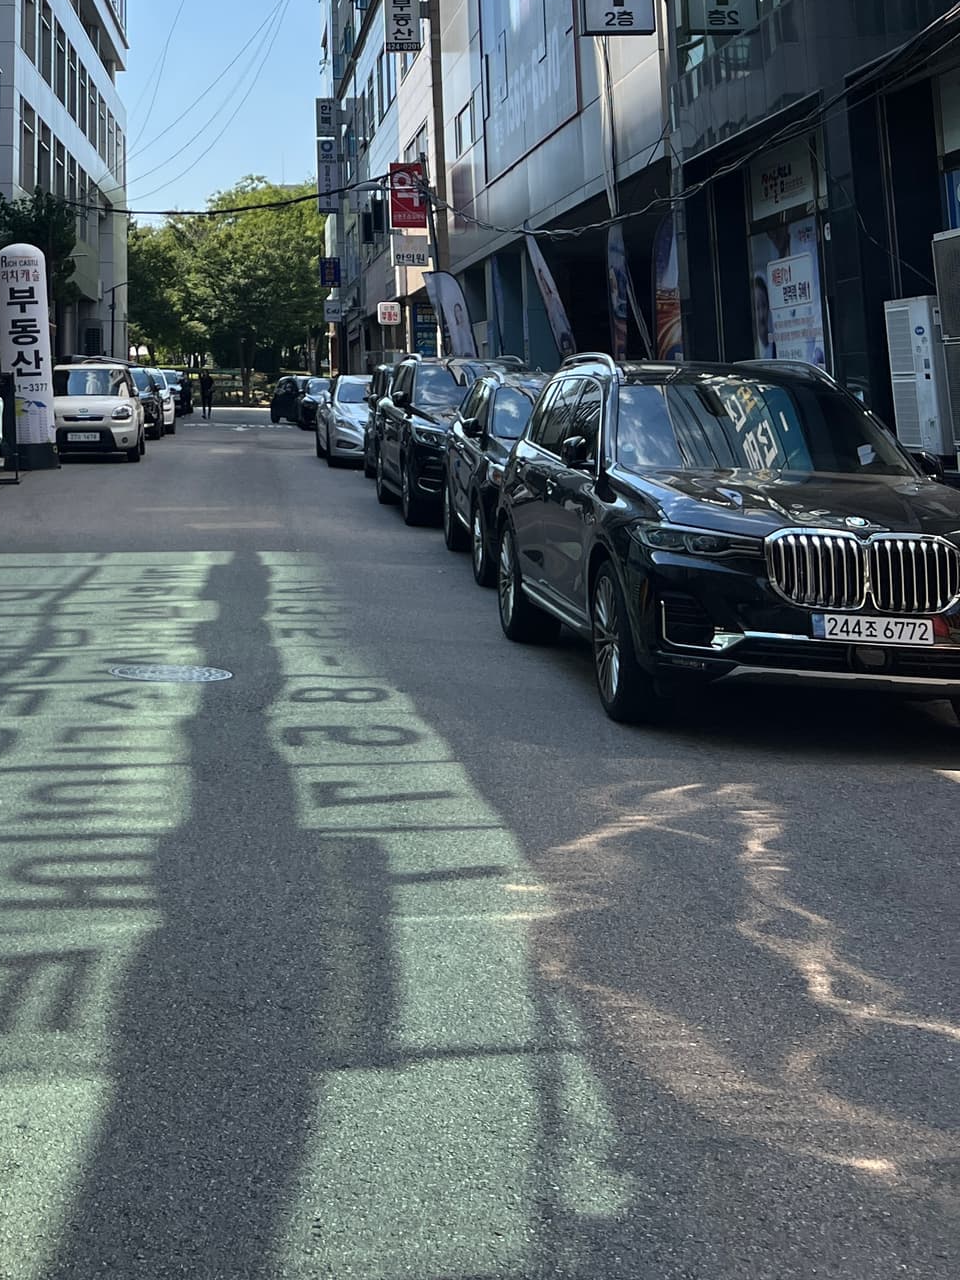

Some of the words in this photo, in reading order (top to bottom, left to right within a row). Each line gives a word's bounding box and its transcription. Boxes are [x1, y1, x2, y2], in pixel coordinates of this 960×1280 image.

[604, 10, 634, 26] 2층
[0, 255, 18, 269] RICH
[395, 253, 425, 264] 한의원
[1, 269, 41, 283] 리치캐슬
[7, 286, 44, 378] 부동산
[827, 617, 878, 638] 244조
[883, 620, 929, 641] 6772
